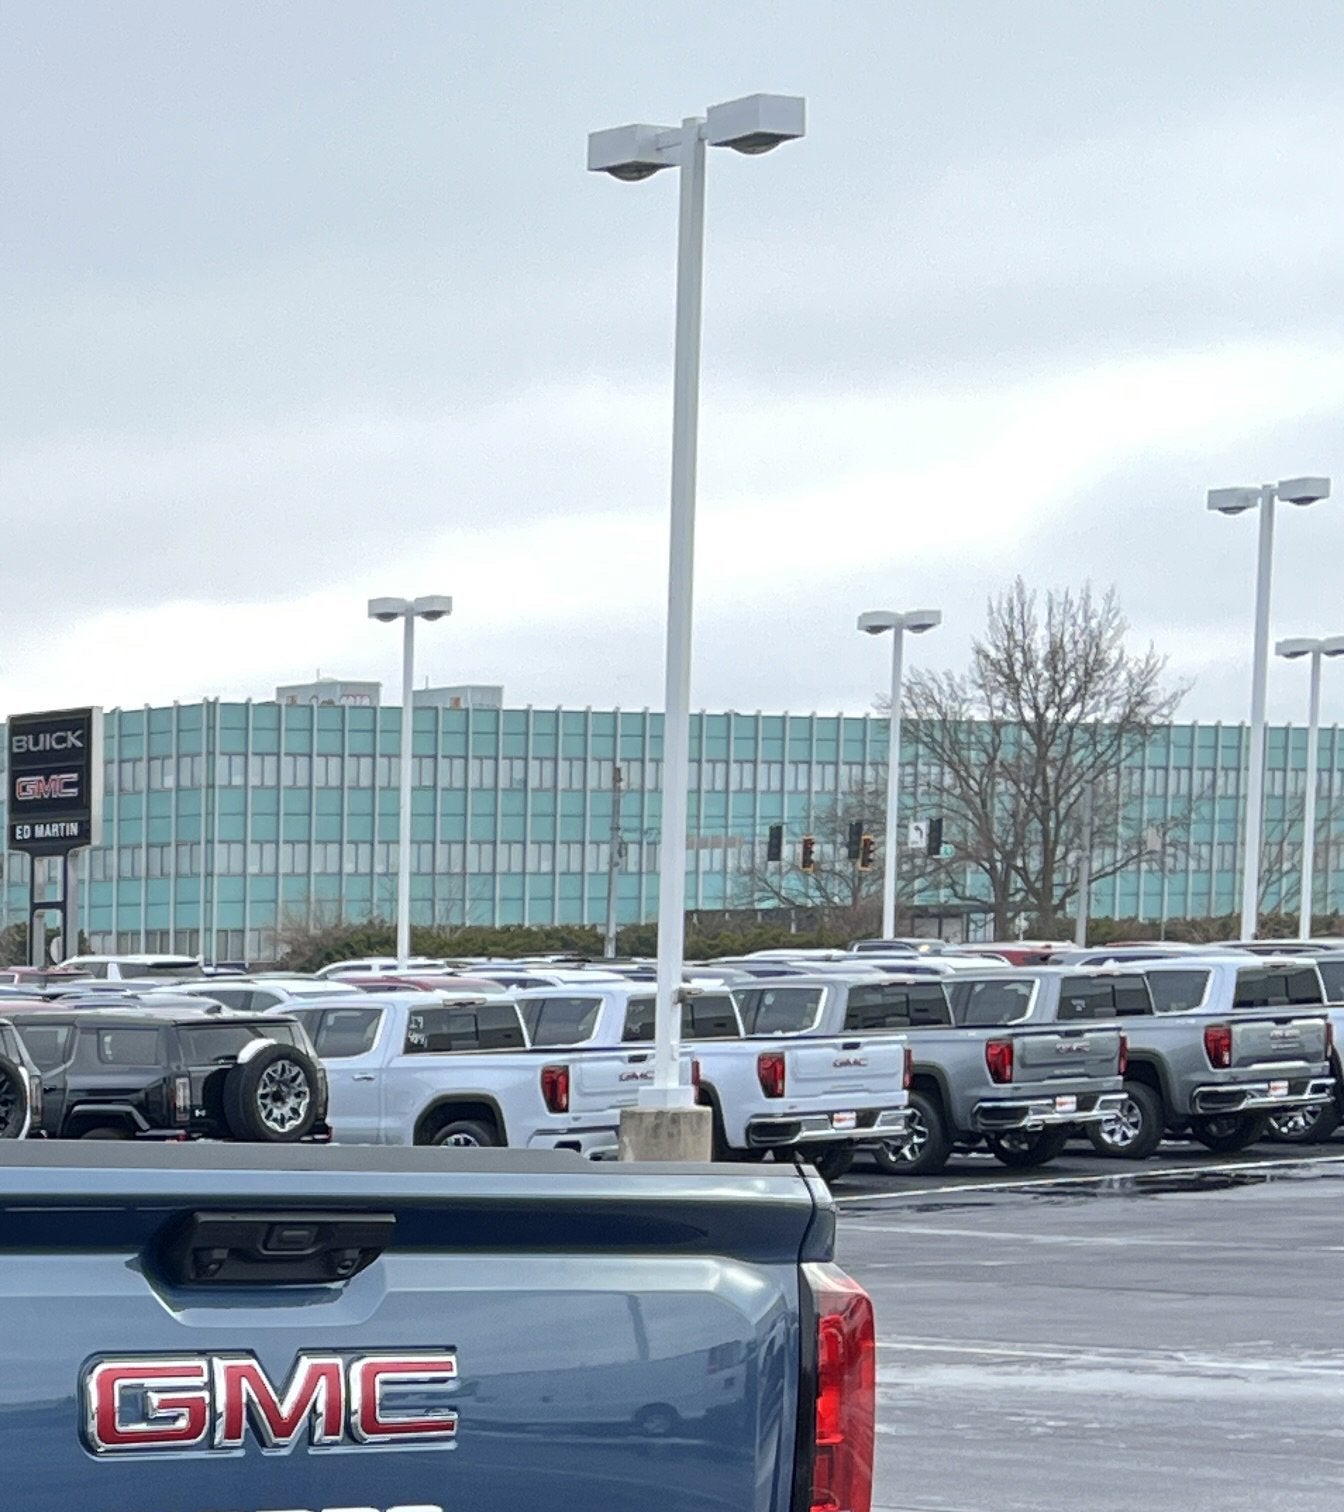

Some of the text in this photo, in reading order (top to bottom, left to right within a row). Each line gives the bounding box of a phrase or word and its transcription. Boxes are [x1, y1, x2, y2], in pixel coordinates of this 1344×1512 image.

[13, 730, 83, 752] BUICK
[16, 774, 78, 800] GMC
[15, 822, 78, 839] ED MARTIN
[82, 1352, 459, 1458] GMC
